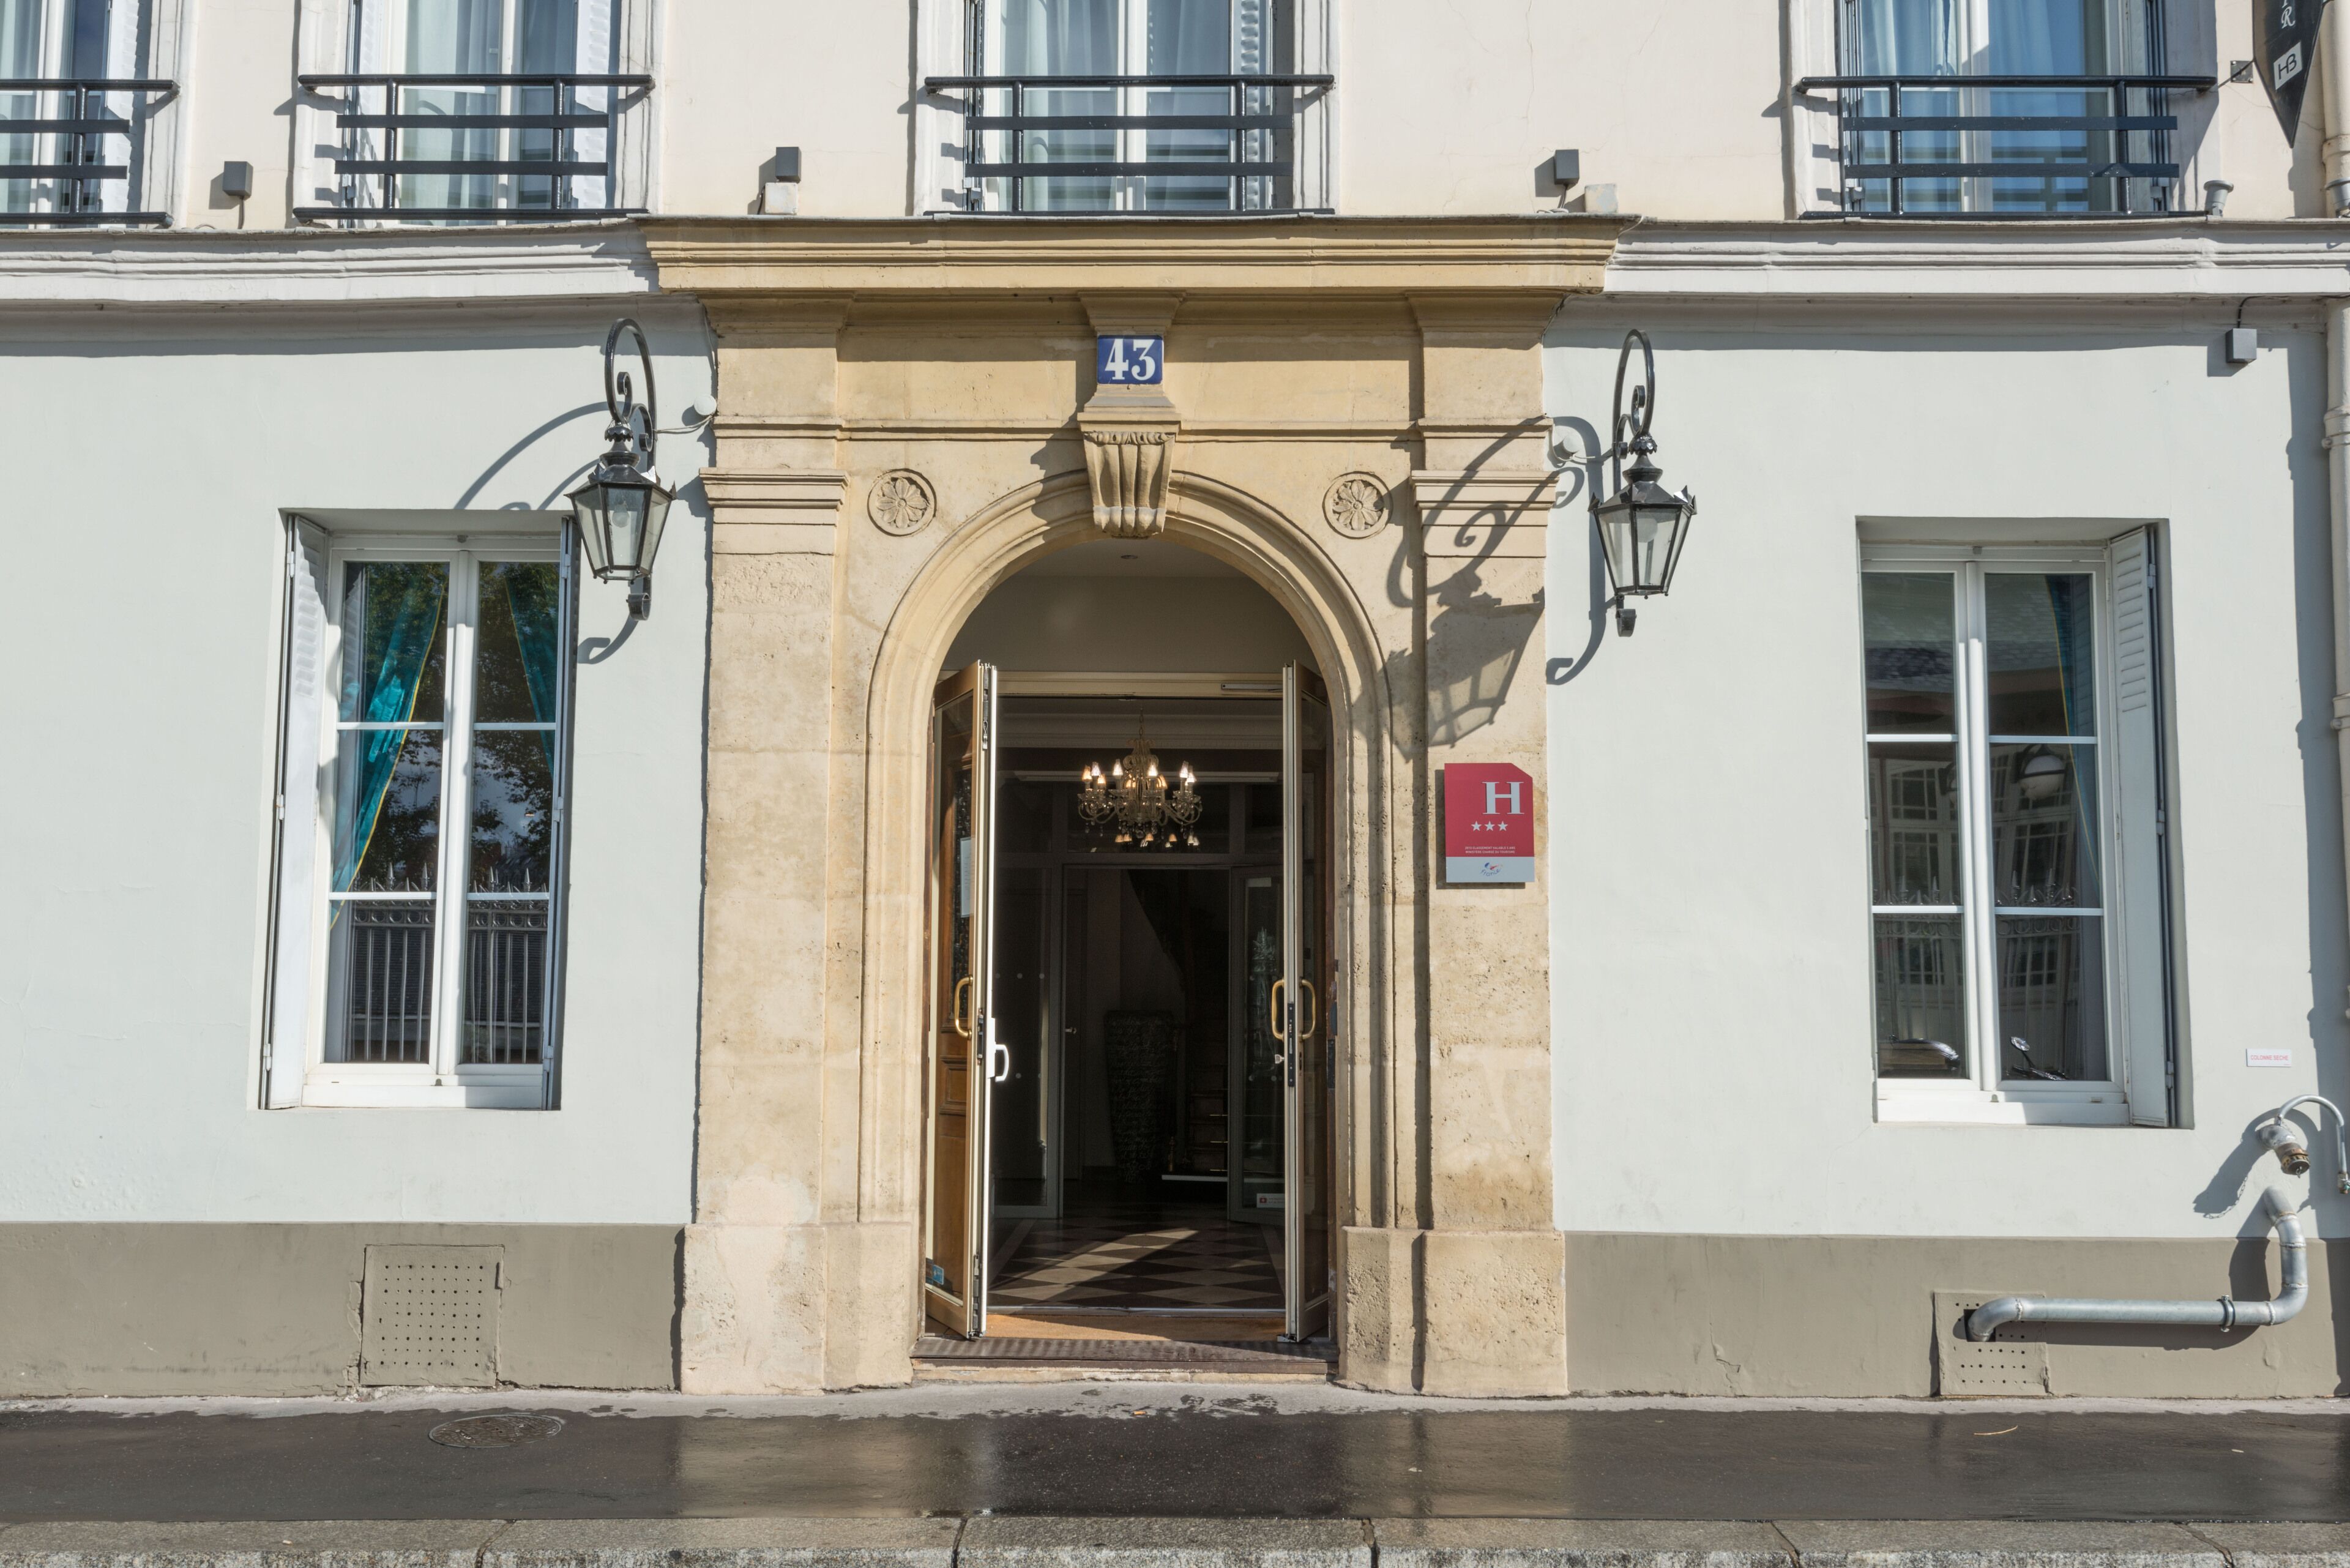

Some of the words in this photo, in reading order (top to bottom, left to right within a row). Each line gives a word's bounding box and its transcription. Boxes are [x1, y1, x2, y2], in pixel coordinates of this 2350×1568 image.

[2278, 53, 2297, 80] HB
[1105, 338, 1155, 381] 43
[1482, 782, 1524, 815] H
